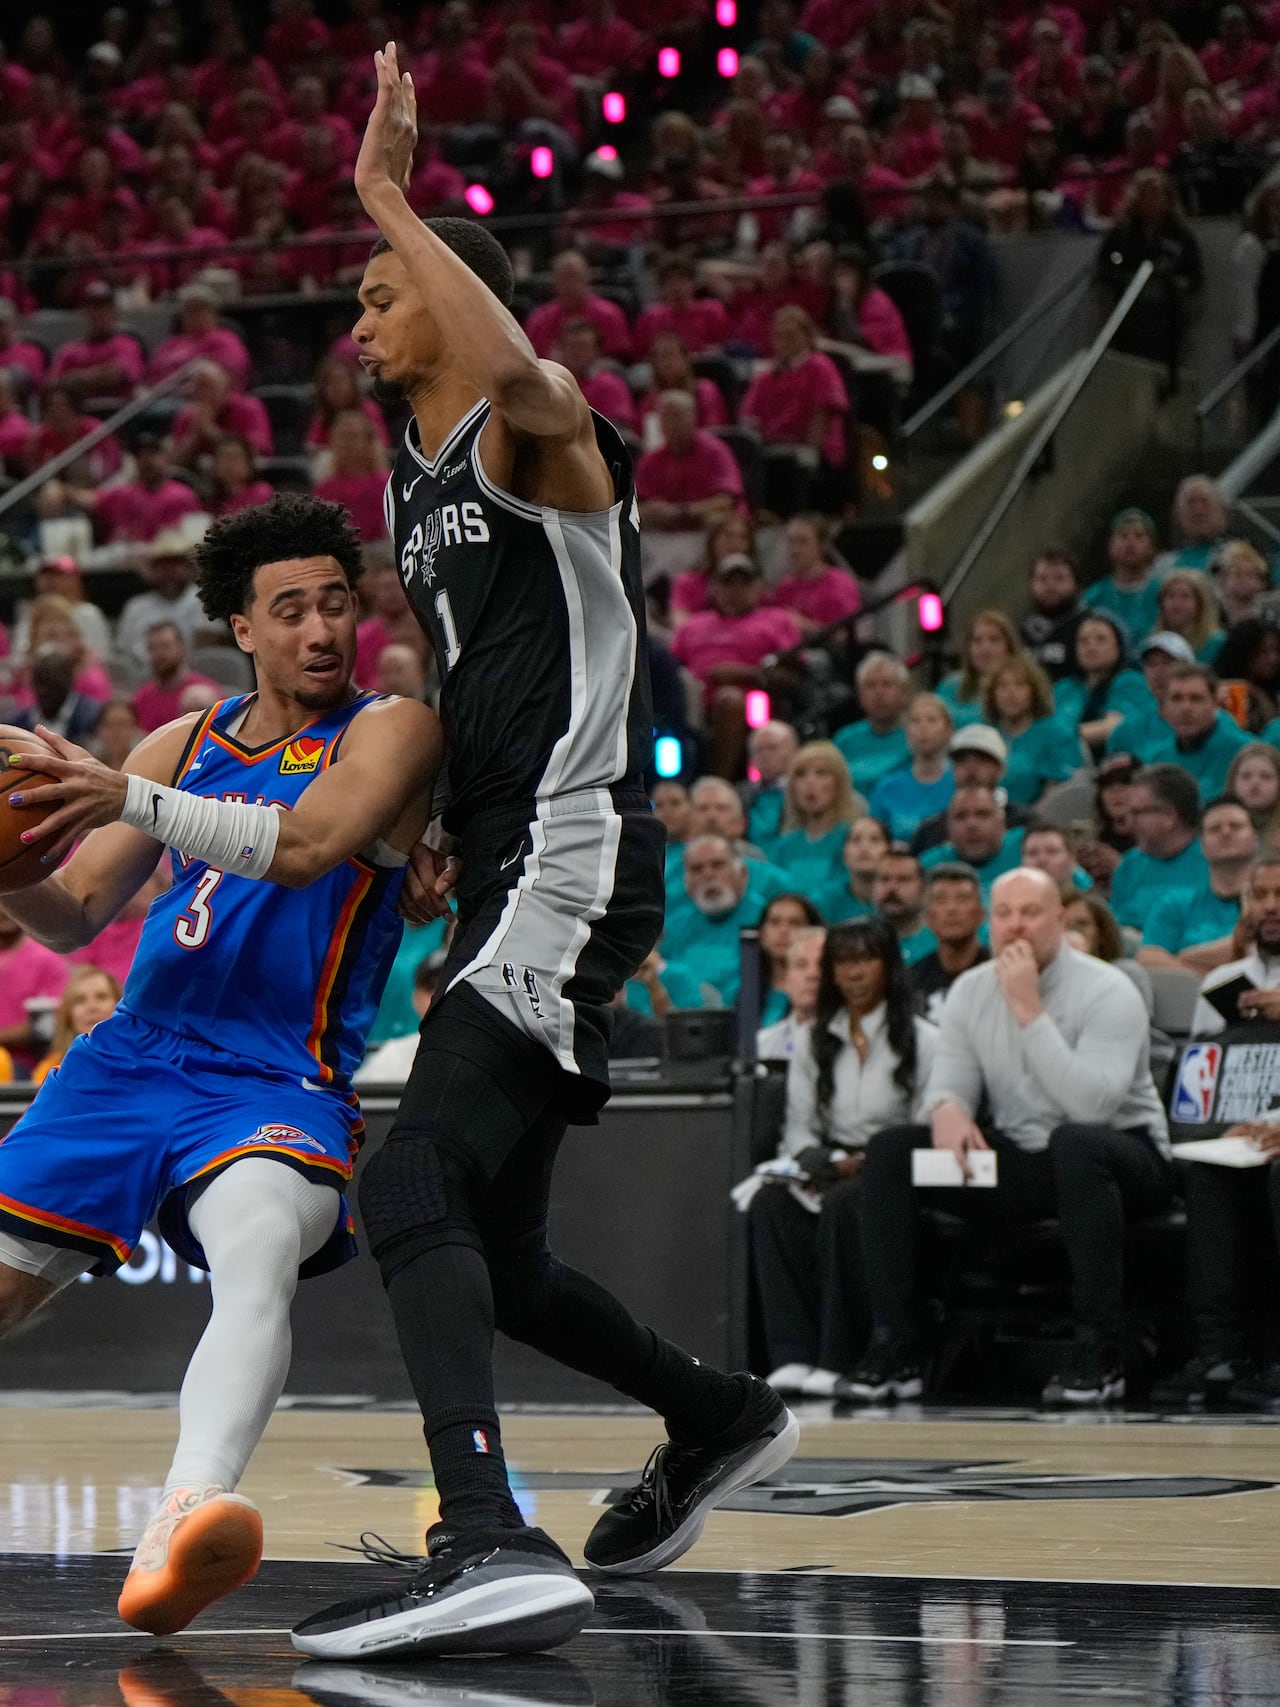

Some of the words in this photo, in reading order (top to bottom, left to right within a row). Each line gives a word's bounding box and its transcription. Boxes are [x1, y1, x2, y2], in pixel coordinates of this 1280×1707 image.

[401, 501, 491, 588] SPURS
[435, 588, 462, 672] 1
[173, 866, 223, 949] 3
